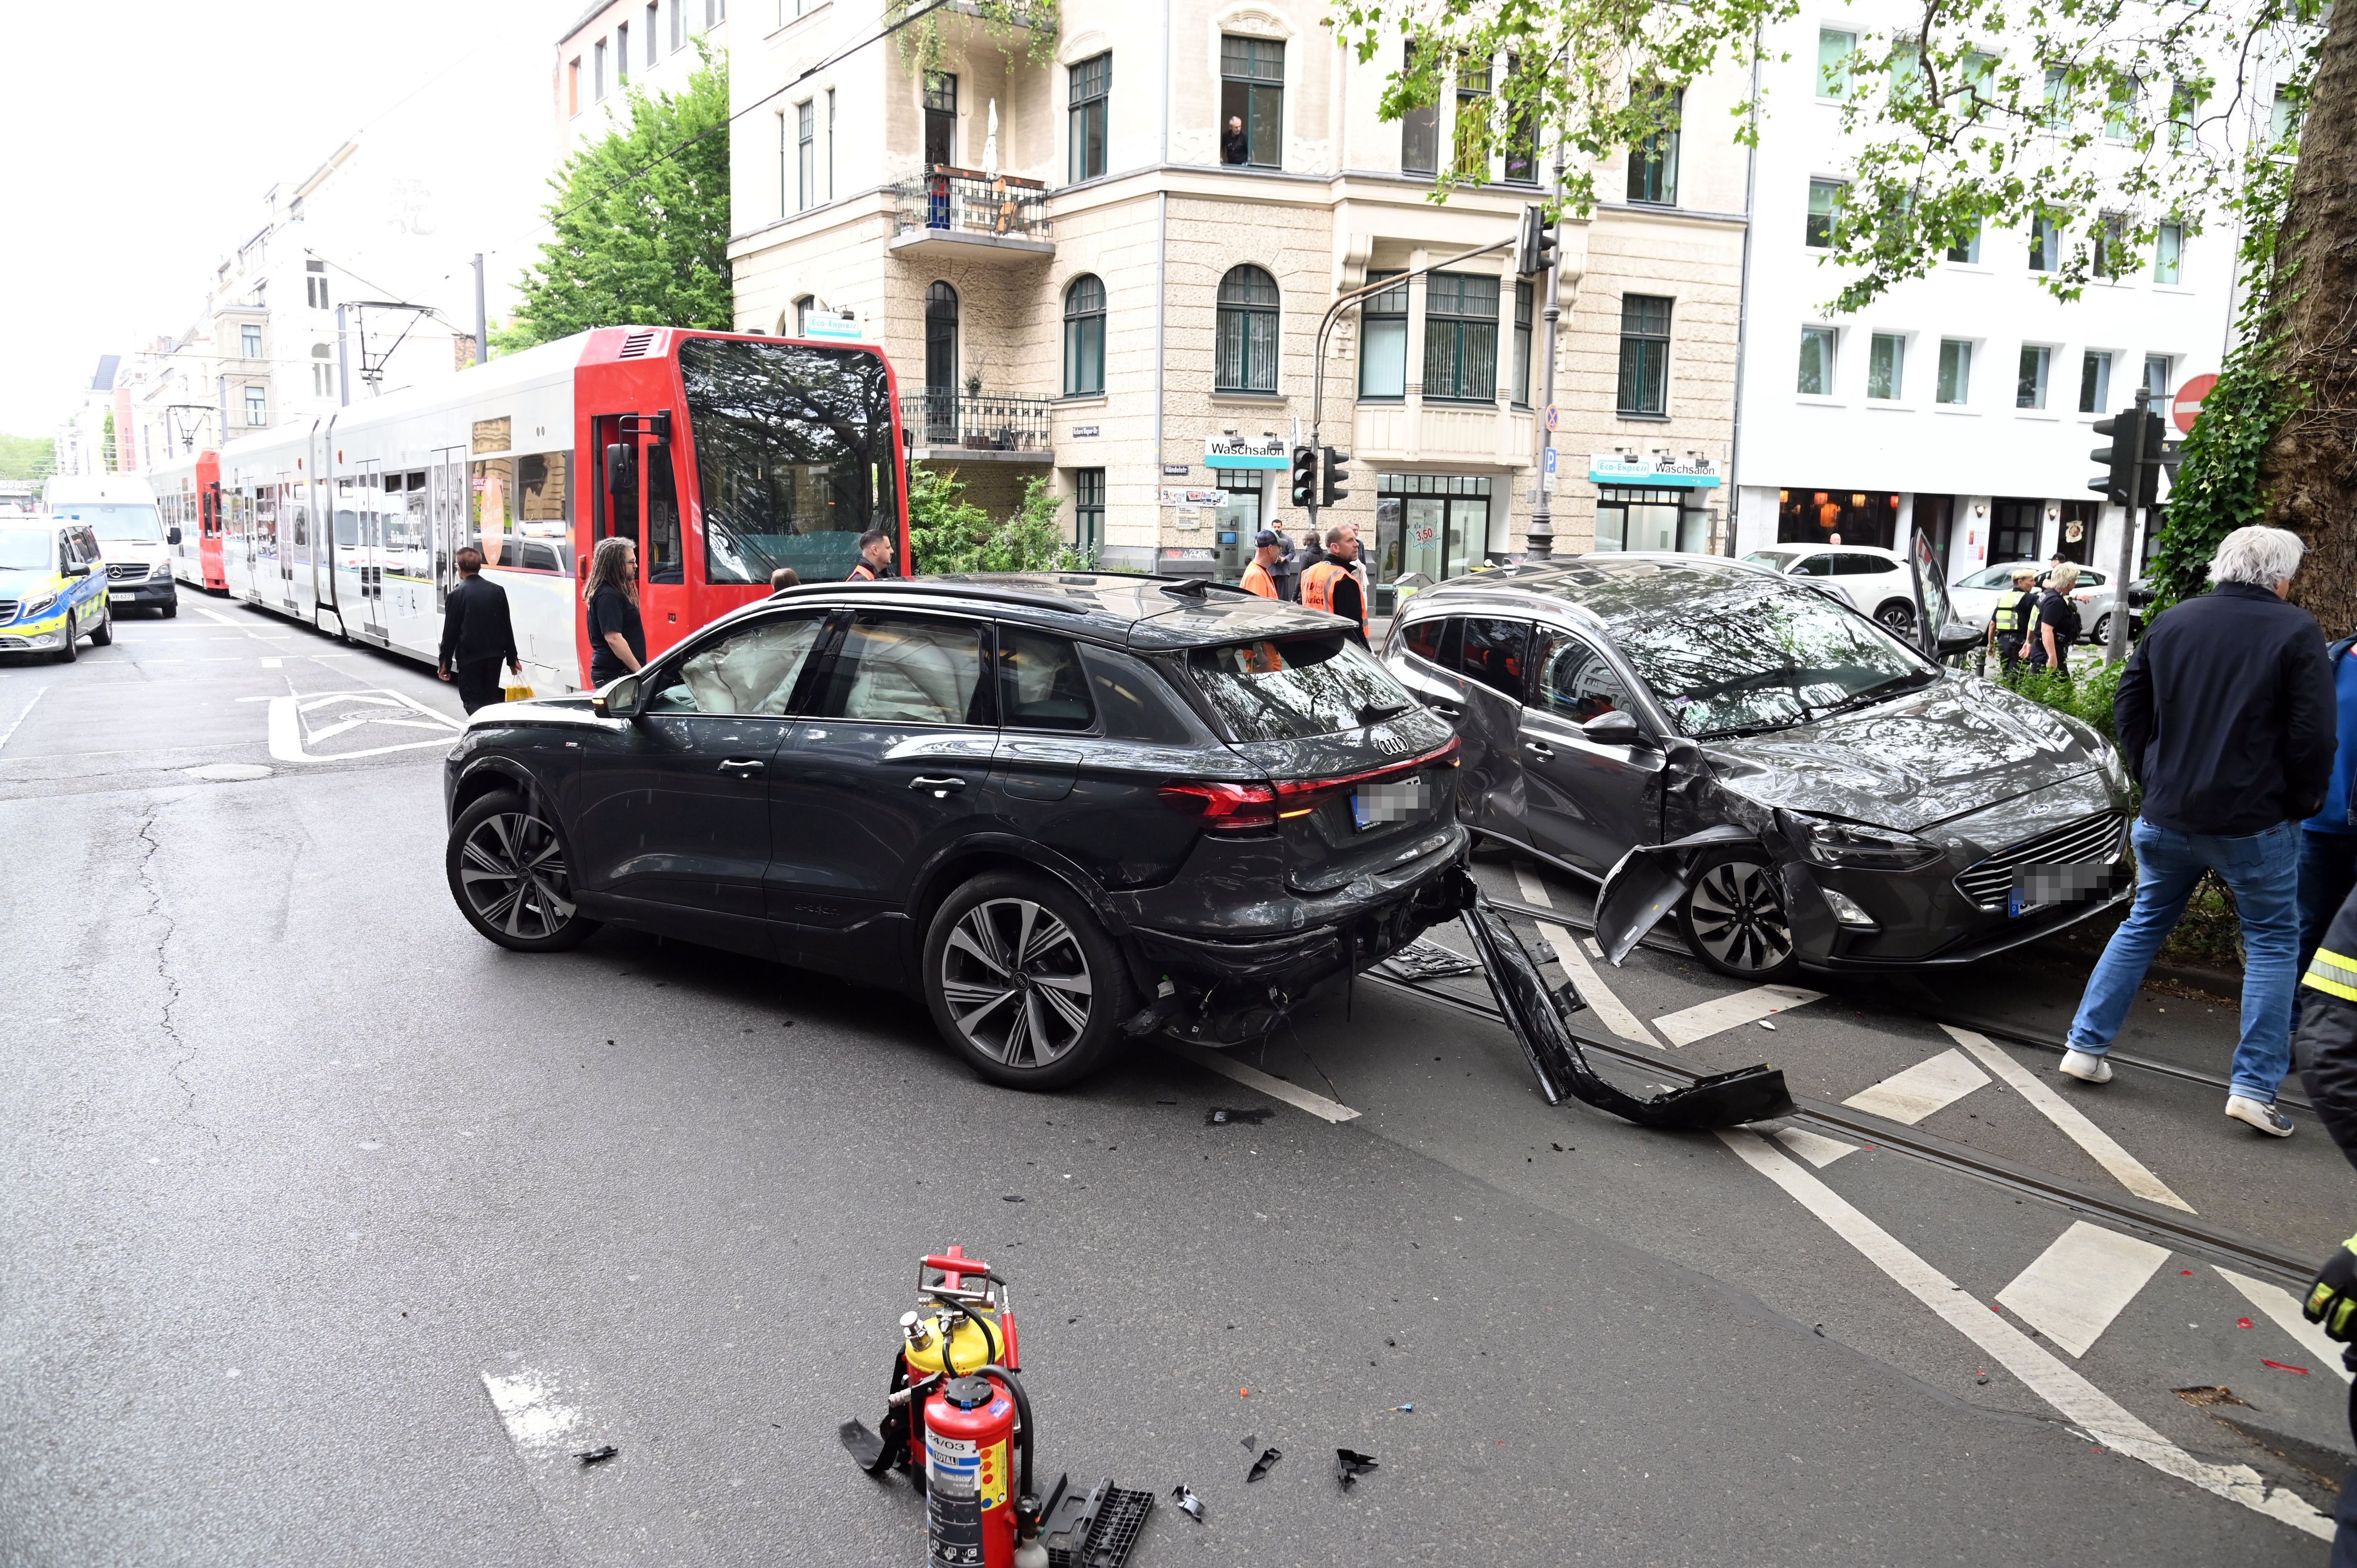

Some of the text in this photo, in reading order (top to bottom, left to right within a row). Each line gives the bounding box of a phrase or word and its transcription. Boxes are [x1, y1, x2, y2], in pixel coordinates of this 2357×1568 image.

[811, 319, 856, 329] Eco-Express
[1211, 443, 1284, 456] Waschsalon
[1599, 462, 1715, 475] Eco-Express Waschsalon
[1416, 528, 1433, 542] 3,50
[935, 1452, 956, 1466] TOTAL
